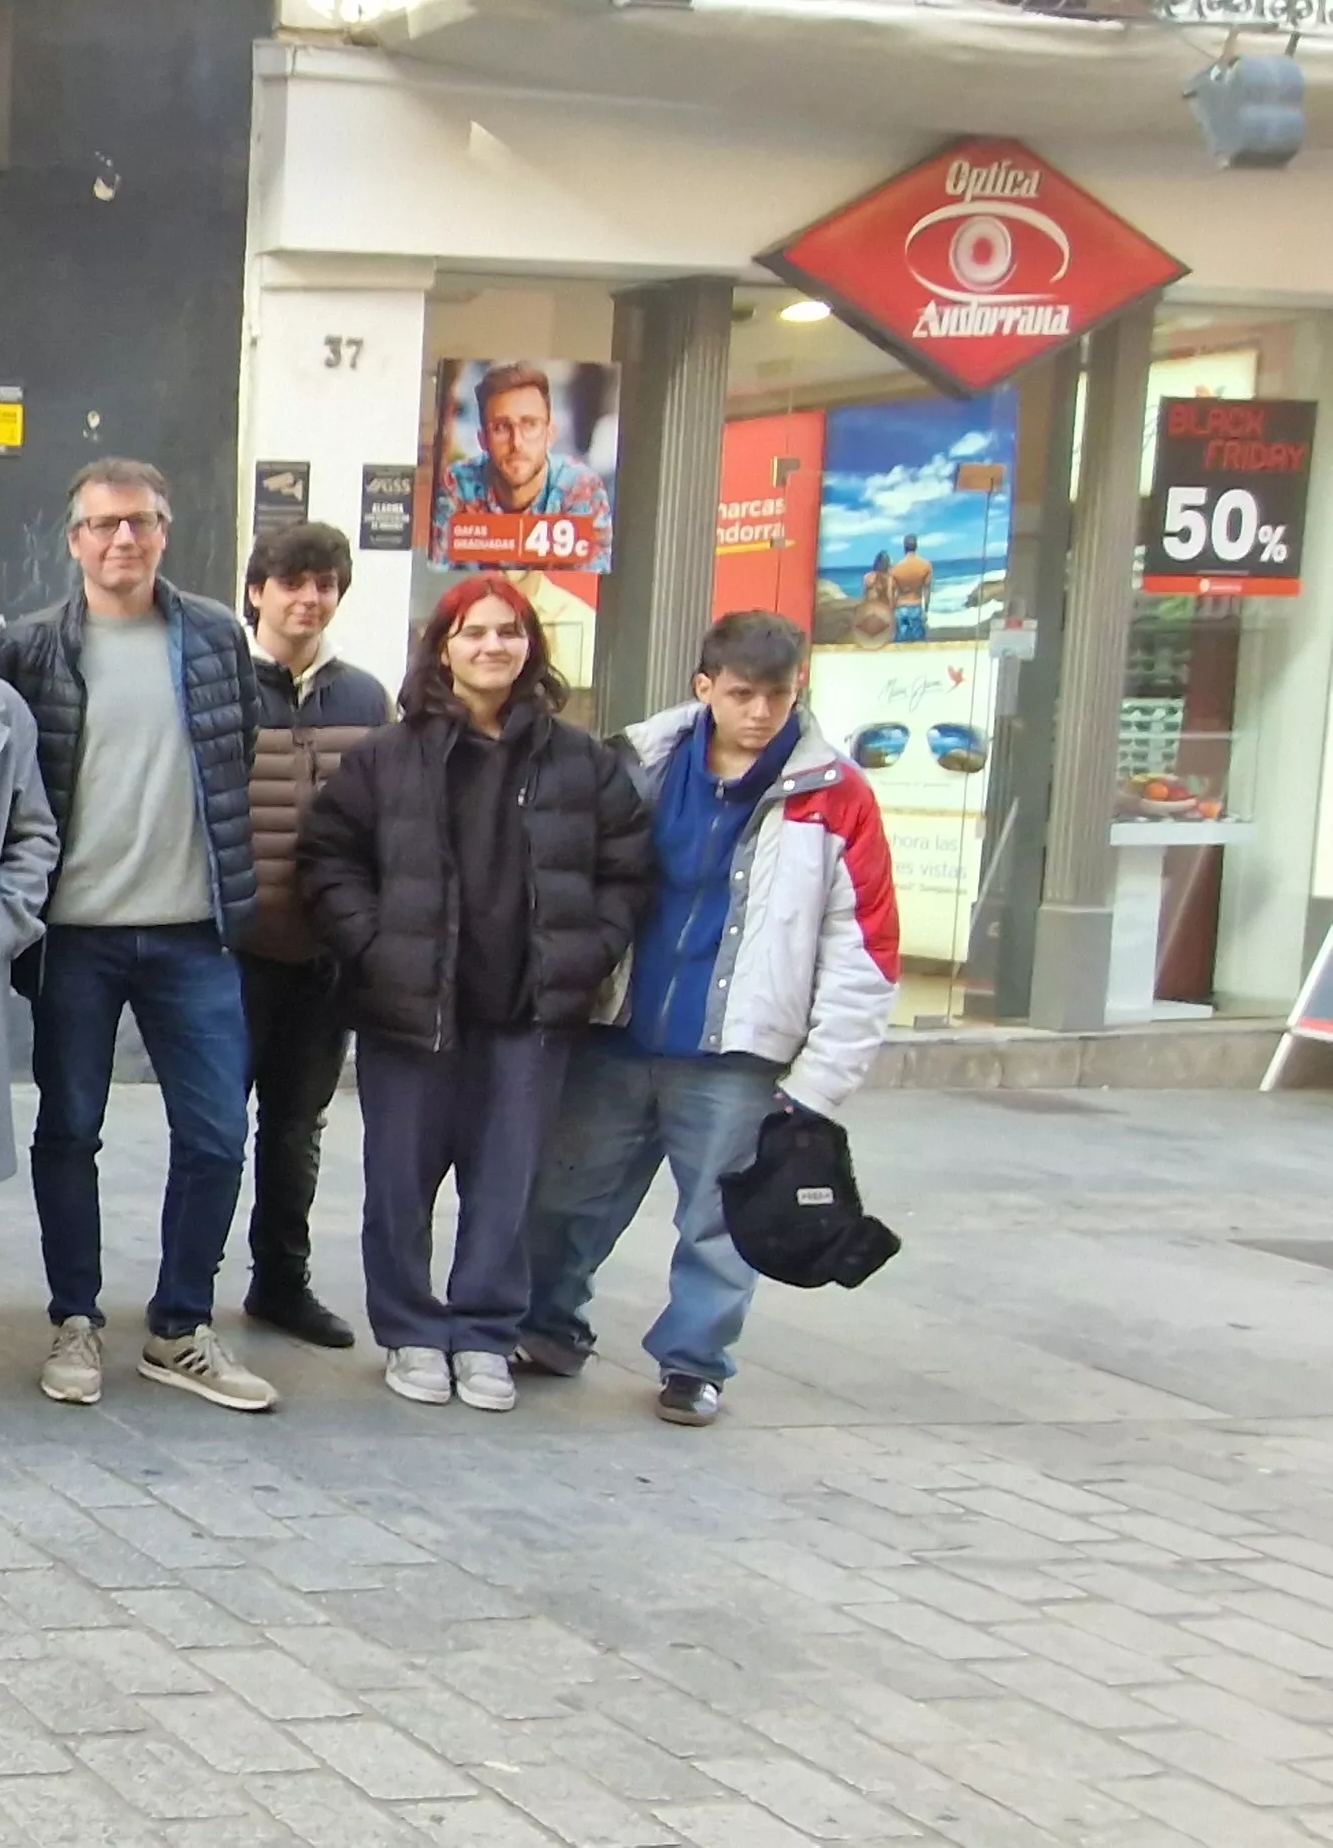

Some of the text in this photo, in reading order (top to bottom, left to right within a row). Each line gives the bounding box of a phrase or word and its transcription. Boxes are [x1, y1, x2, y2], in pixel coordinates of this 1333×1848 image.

[912, 299, 1070, 338] Andorrana
[324, 335, 365, 371] 37
[1167, 403, 1267, 437] BLACK
[1202, 439, 1309, 471] FRIDAY
[1162, 486, 1290, 563] 50%
